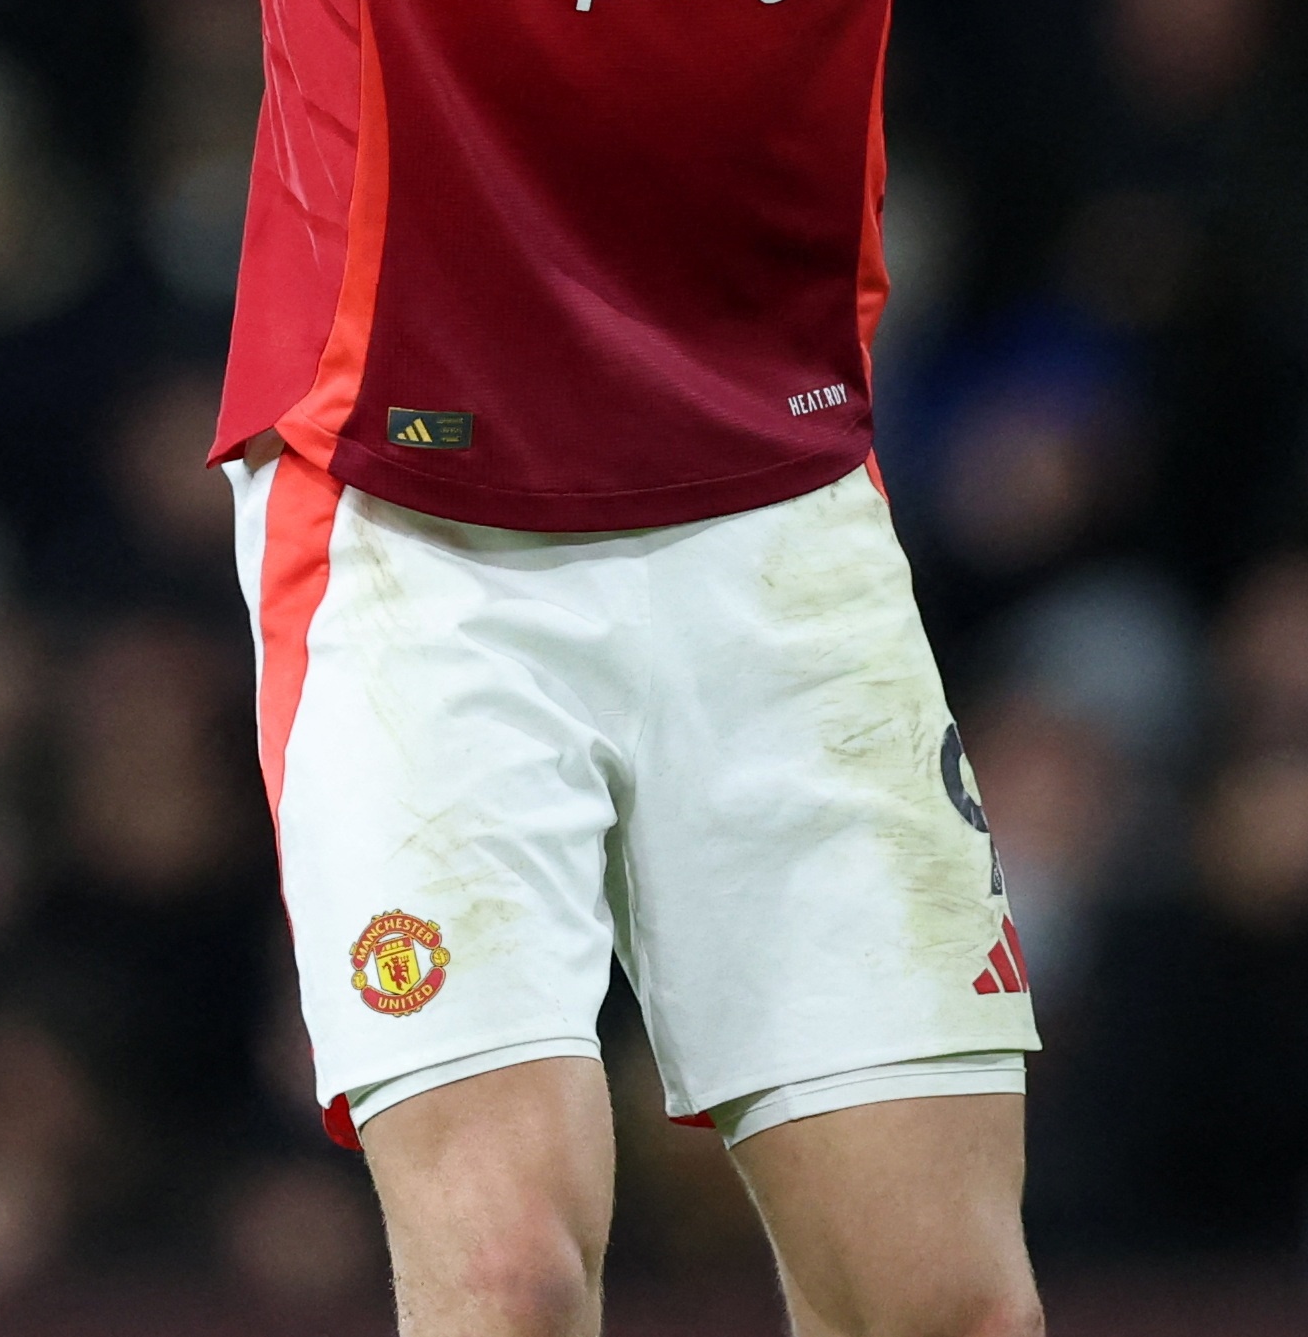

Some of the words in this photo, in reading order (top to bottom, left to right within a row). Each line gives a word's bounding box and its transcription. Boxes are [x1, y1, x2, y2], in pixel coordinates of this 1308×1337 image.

[787, 382, 848, 417] HEAT.RDY
[356, 917, 435, 962] MANCHESTER
[377, 984, 434, 1010] UNITED
